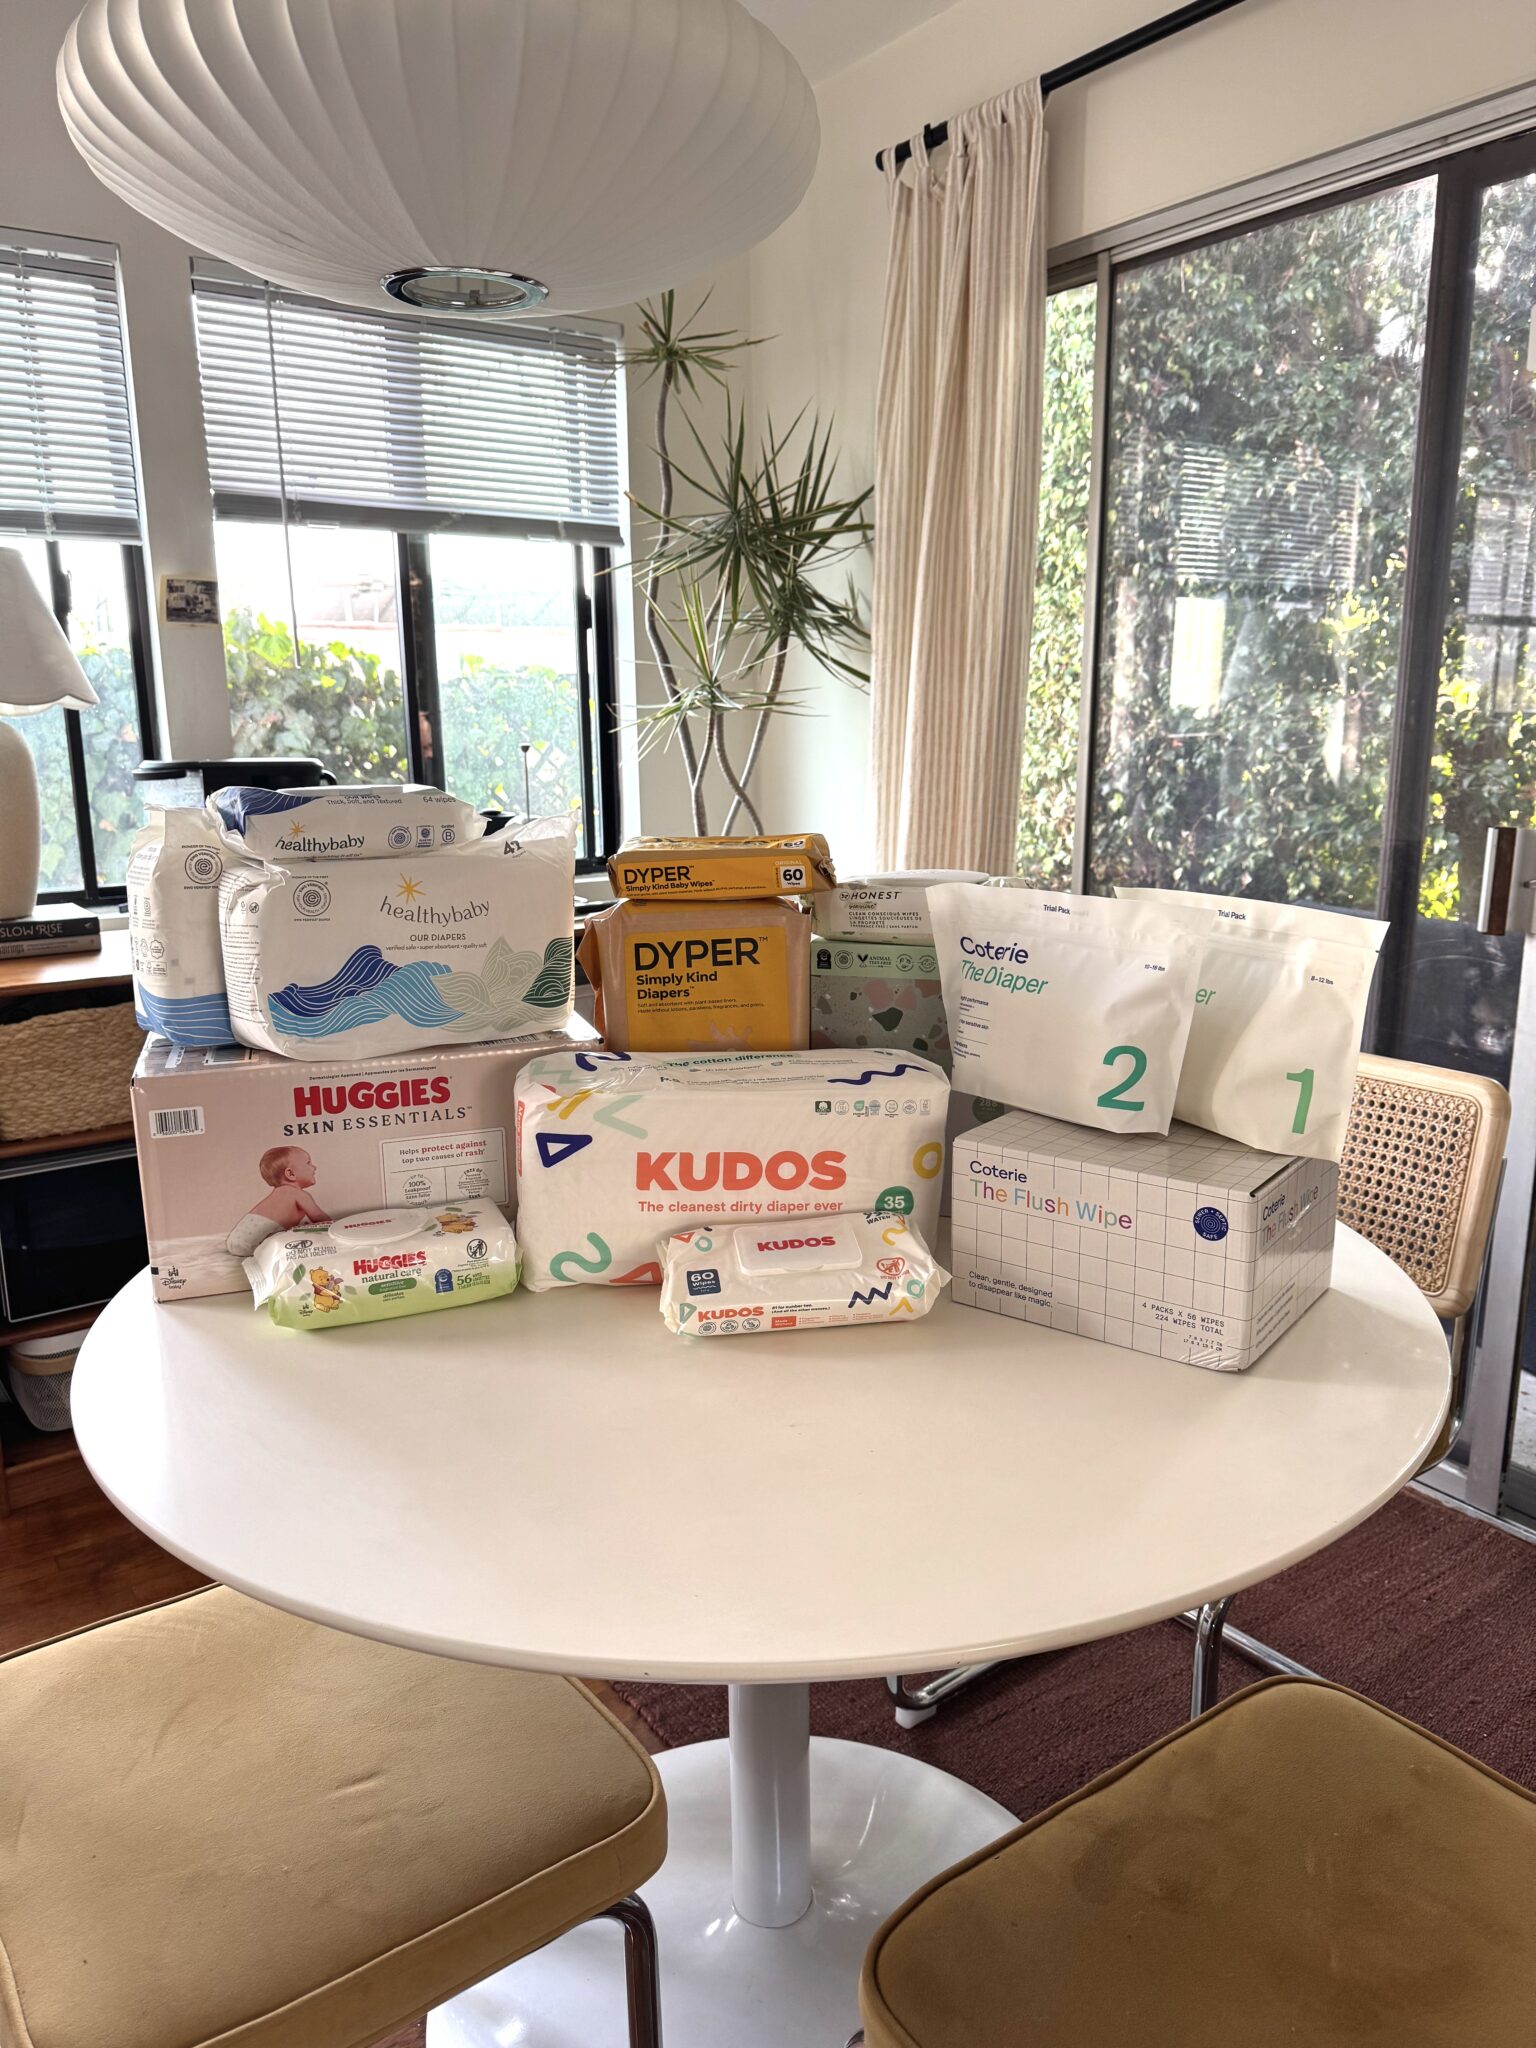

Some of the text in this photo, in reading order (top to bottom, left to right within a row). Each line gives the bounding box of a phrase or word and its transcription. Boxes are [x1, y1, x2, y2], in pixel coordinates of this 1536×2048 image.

[423, 796, 456, 804] 64 wipes
[275, 834, 365, 853] healthybaby
[503, 840, 523, 856] 42
[624, 865, 691, 885] DYPER
[783, 868, 803, 881] 60
[670, 882, 689, 890] Baby
[690, 880, 713, 888] Wipes
[851, 891, 901, 900] HONEST
[380, 895, 490, 928] healthybaby
[1043, 904, 1070, 915] Trial Pack
[1218, 910, 1246, 920] Trial Pack
[0, 923, 63, 938] SLOW RISE
[410, 933, 467, 942] OUR DIAPERS
[960, 936, 1029, 964] Coterie
[636, 971, 718, 986] Simply Kind
[961, 959, 1048, 994] The Diaper
[637, 988, 690, 1000] Diapers
[693, 1057, 732, 1065] cotton
[1097, 1045, 1147, 1112] 2
[293, 1076, 450, 1117] HUGGIES
[1286, 1068, 1315, 1134] 1
[283, 1107, 467, 1136] SKIN ESSENTIALS
[400, 1140, 487, 1156] Helps protect against
[431, 1153, 455, 1161] causes
[636, 1150, 847, 1191] KUDOS
[970, 1160, 1027, 1183] Coterie
[638, 1200, 844, 1214] The cleanest dirty diaper ever
[884, 1196, 905, 1209] 35
[970, 1179, 1132, 1229] The Flush Wipe
[1263, 1194, 1285, 1221] Coterie
[344, 1219, 392, 1229] HUGGIES
[866, 1215, 891, 1225] WATER
[1195, 1209, 1227, 1231] SEWER SEPTIC
[1263, 1223, 1277, 1247] The
[297, 1247, 312, 1255] NOT
[757, 1236, 836, 1252] KUDOS
[353, 1250, 427, 1275] HUGGIES
[160, 1277, 187, 1286] Disney
[361, 1267, 422, 1284] natural care
[457, 1273, 472, 1286] 56
[691, 1272, 714, 1282] 60
[969, 1271, 1052, 1298] Clean, gentle, designed
[977, 1283, 1012, 1297] disappear
[1014, 1292, 1027, 1300] like
[1028, 1296, 1053, 1308] magic.
[698, 1306, 765, 1322] KUDOS
[1151, 1304, 1173, 1314] PACKS
[1201, 1316, 1224, 1327] WIPES
[1155, 1314, 1224, 1336] 224 WIPES TOTAL
